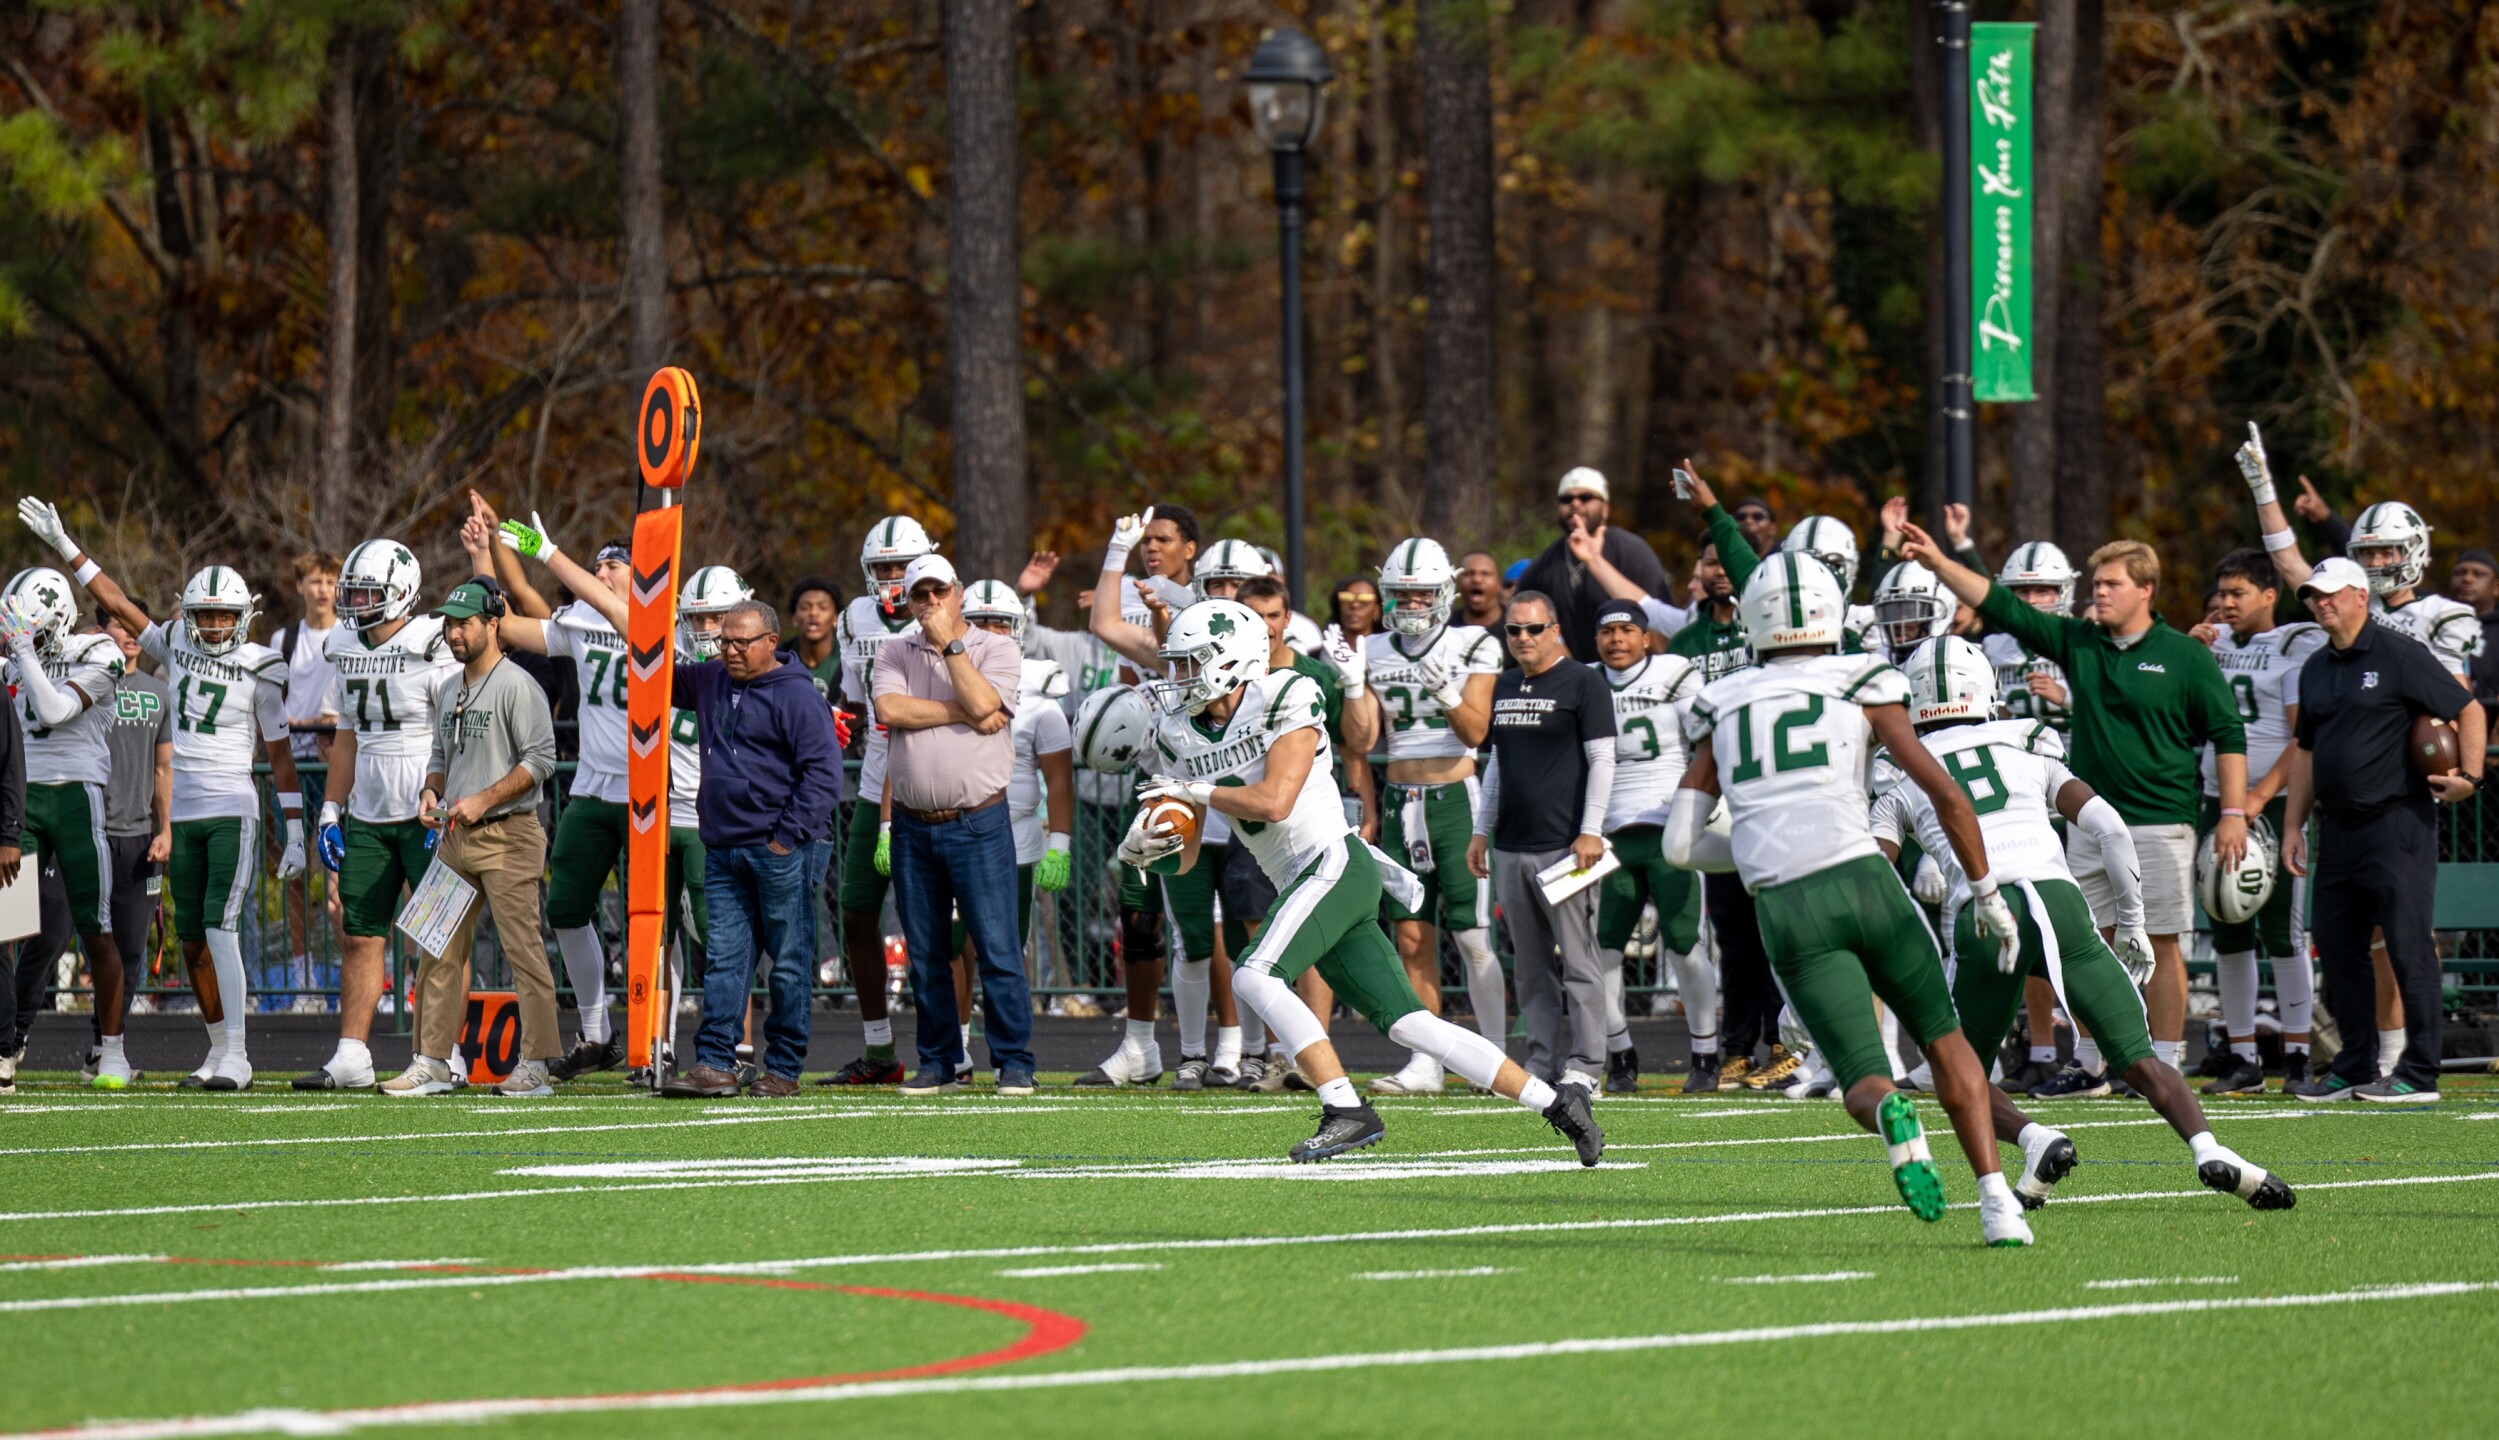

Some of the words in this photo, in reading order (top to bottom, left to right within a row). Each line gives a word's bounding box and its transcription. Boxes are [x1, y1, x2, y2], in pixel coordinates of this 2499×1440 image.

[1977, 48, 2018, 130] Path
[1978, 138, 2022, 198] Your
[174, 649, 243, 682] BENEDICTINE
[338, 656, 406, 675] BENEDICTINE
[116, 690, 160, 720] CP
[178, 675, 227, 735] 17
[346, 678, 401, 732] 71
[1493, 698, 1557, 712] BENEDICTINE
[1493, 713, 1542, 726] FOOTBALL
[1919, 704, 1969, 719] Riddell
[1616, 716, 1661, 763] 3
[1732, 693, 1830, 785] 12
[1943, 744, 2010, 816] 8
[2235, 868, 2264, 896] 40
[459, 999, 521, 1077] 40
